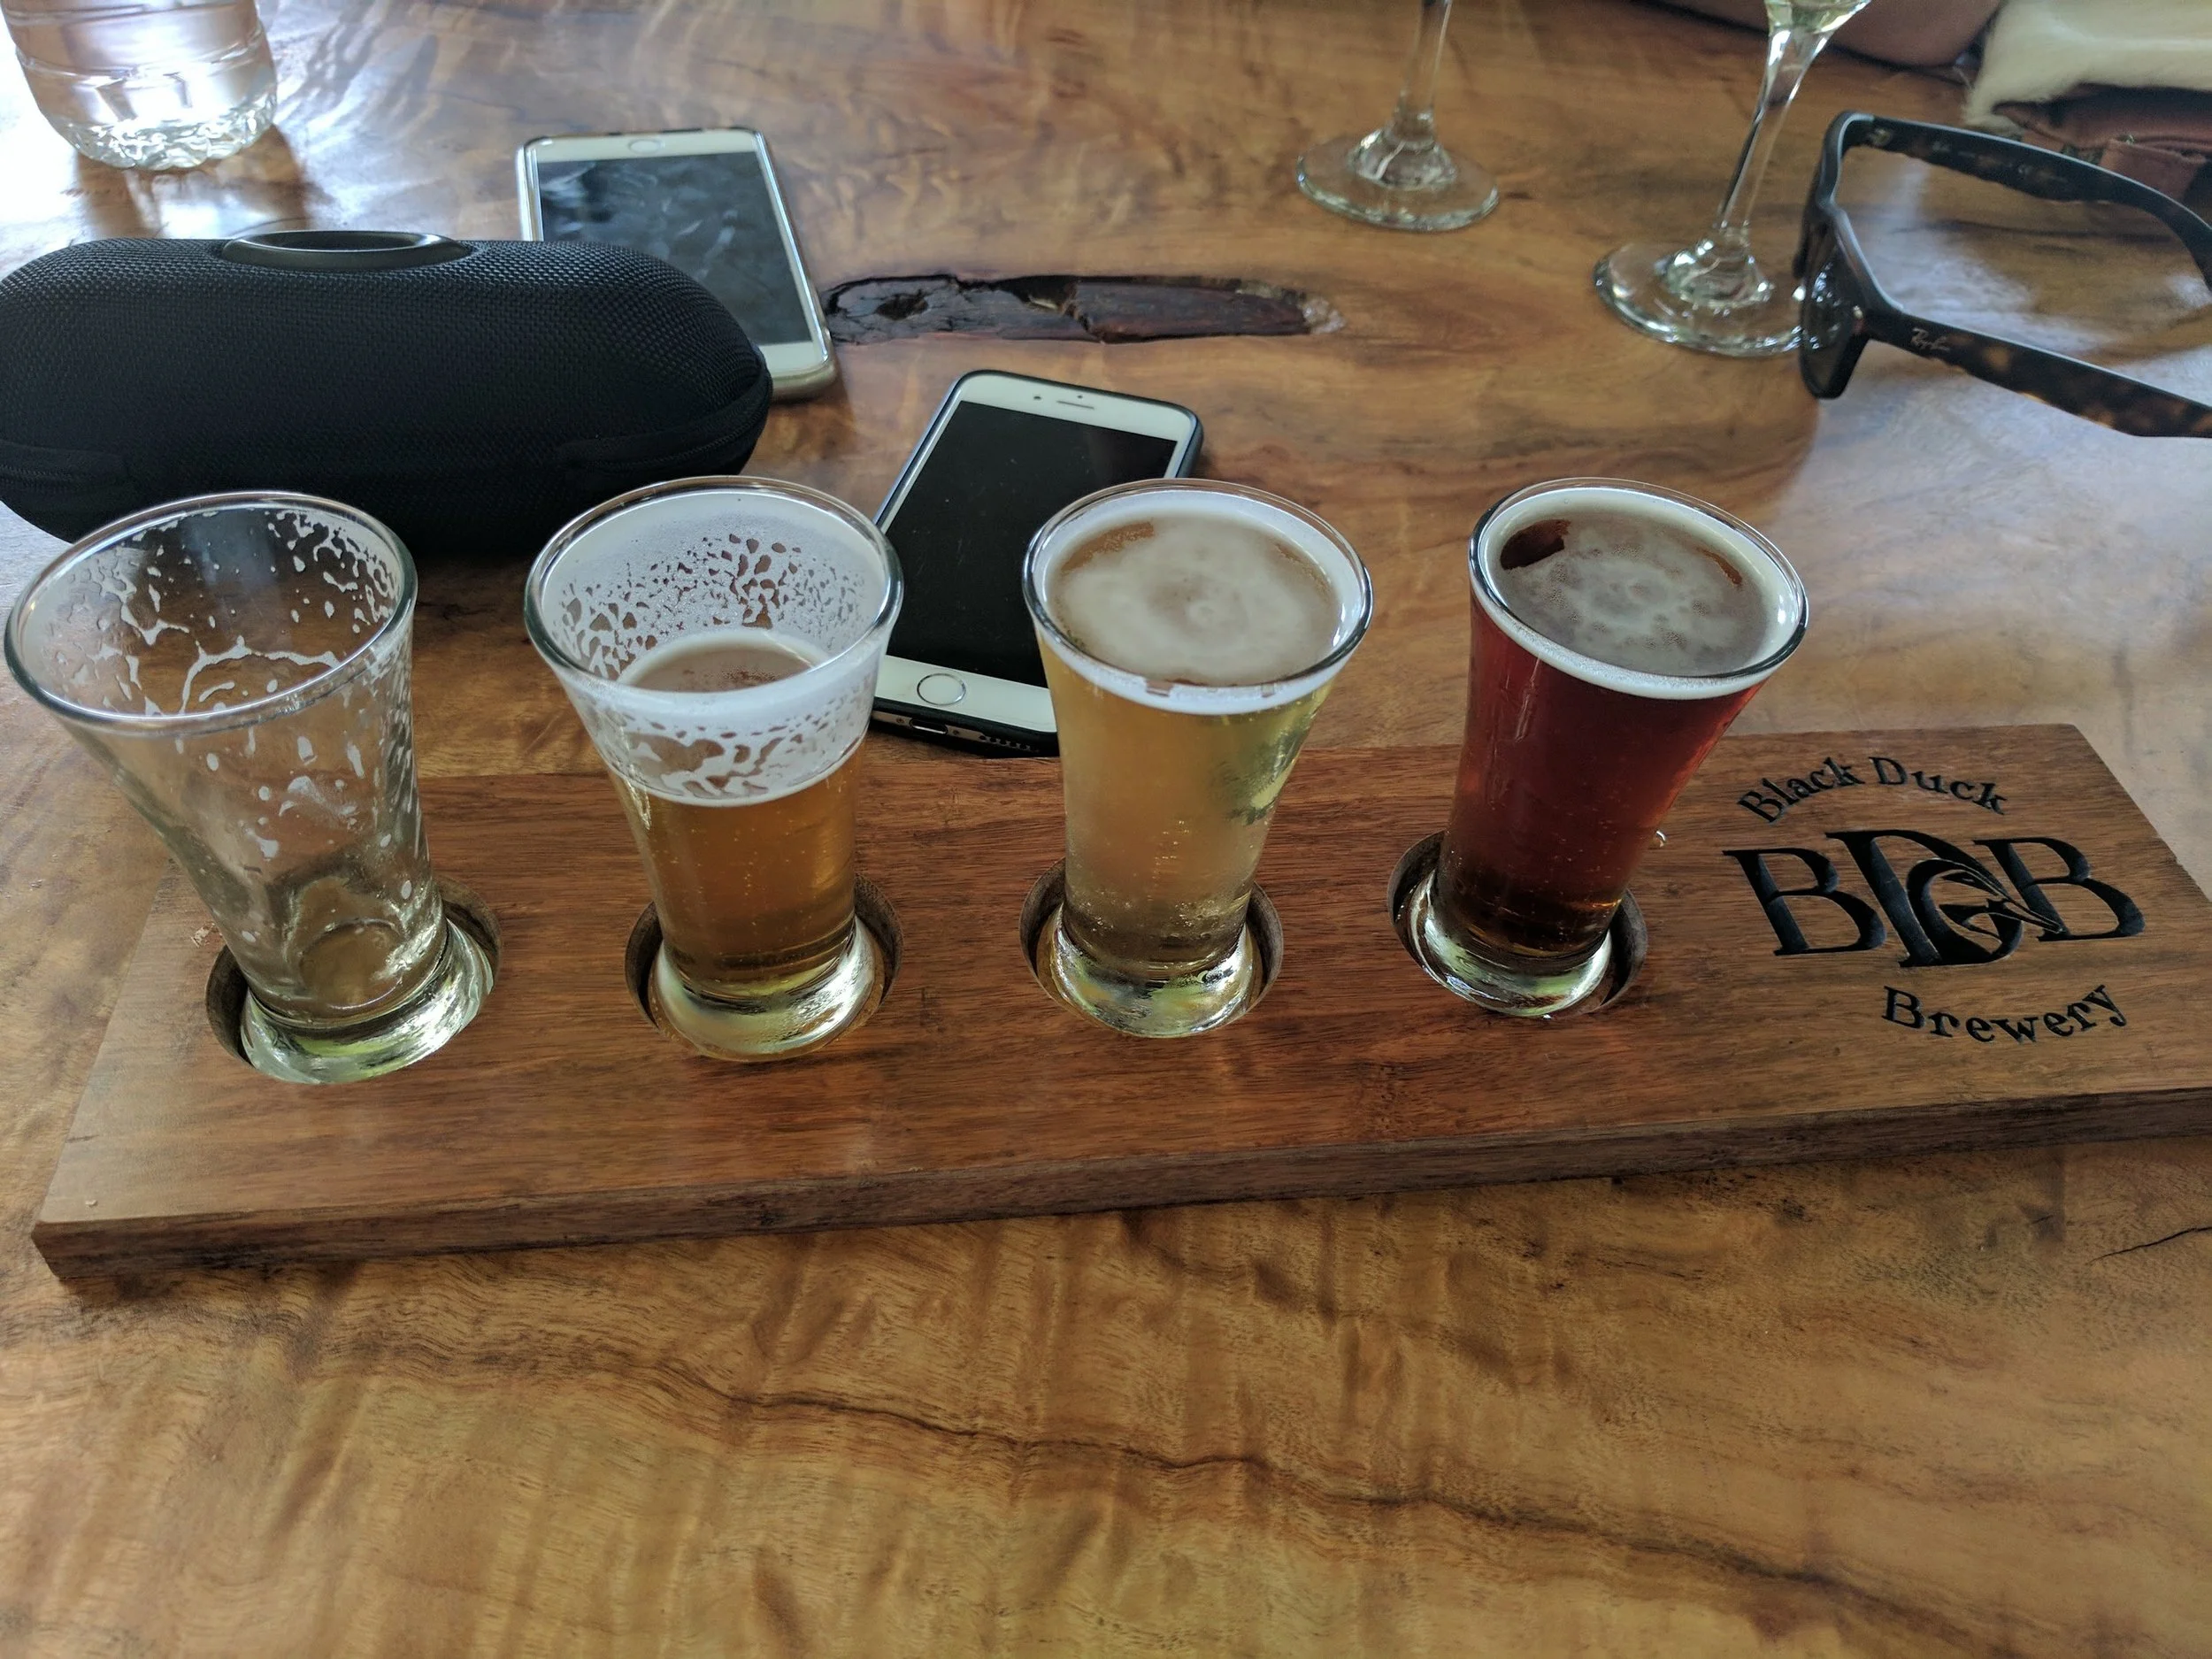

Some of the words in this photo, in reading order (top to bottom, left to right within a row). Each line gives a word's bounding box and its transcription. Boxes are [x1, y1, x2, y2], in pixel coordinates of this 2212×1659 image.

[1737, 757, 1865, 823] Black
[1869, 757, 2008, 815] Duck
[1882, 984, 2127, 1044] Brewery
